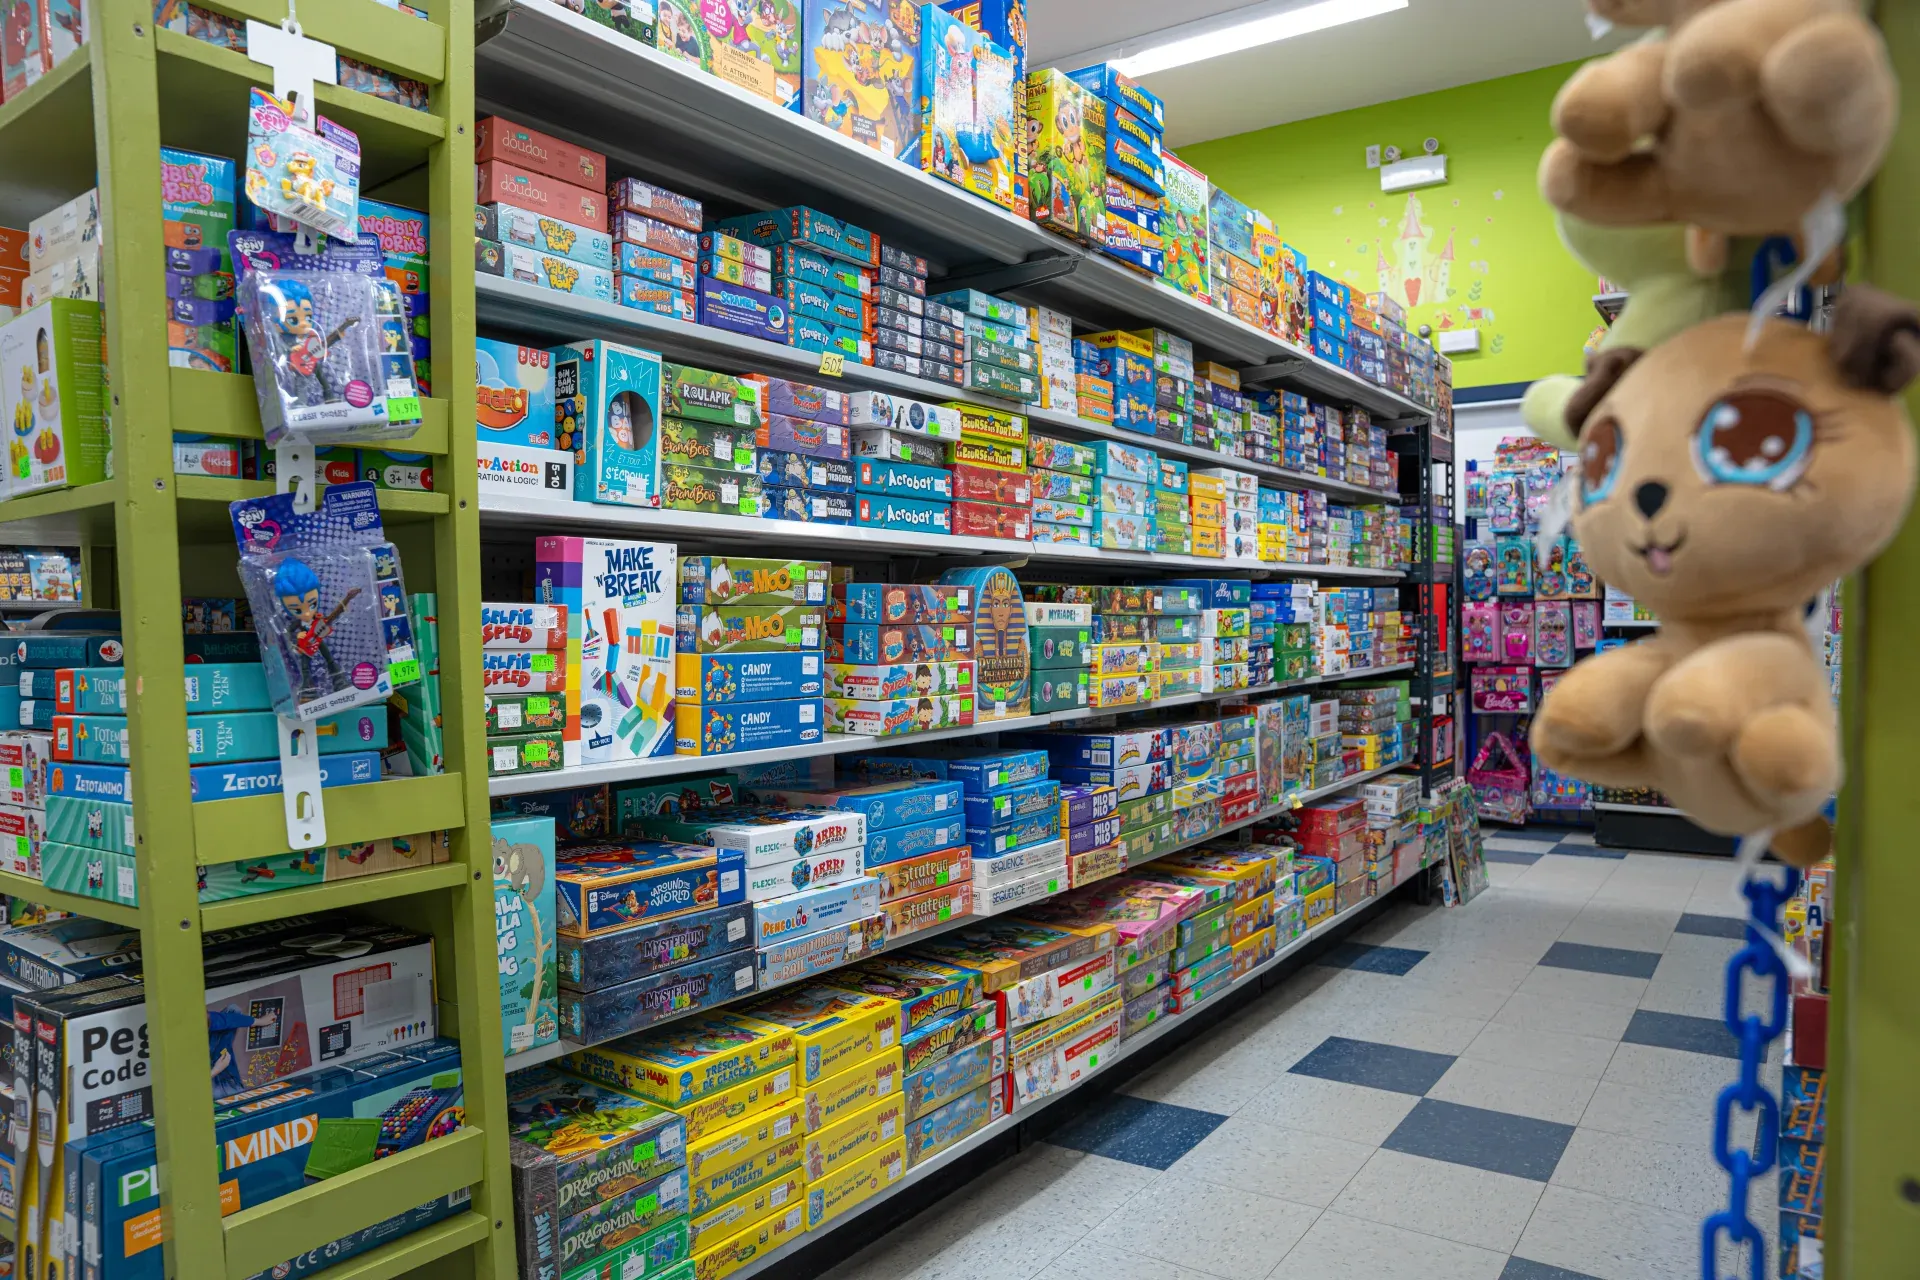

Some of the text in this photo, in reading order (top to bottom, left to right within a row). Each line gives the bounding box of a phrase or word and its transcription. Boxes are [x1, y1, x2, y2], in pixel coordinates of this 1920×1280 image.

[714, 4, 726, 15] 10
[730, 49, 755, 65] WARNING:
[730, 68, 758, 85] ATTENTION
[1119, 83, 1152, 113] PERFECTION
[1018, 81, 1028, 175] MONSTER
[1119, 117, 1150, 147] PERFECTION
[502, 130, 548, 161] doudou
[1119, 150, 1154, 178] PERFECTION
[500, 174, 547, 202] doudou
[744, 246, 756, 262] OXO
[655, 271, 671, 281] KIDS
[744, 267, 756, 284] OXO
[656, 304, 671, 313] KIDS
[1100, 335, 1117, 343] HABA
[823, 356, 843, 373] 50%
[793, 399, 822, 410] DRAGONS
[962, 418, 987, 431] BOURSE
[793, 433, 822, 445] DRAGONS
[963, 446, 987, 460] BOURSE
[332, 468, 349, 477] Kids
[390, 474, 402, 484] 3+
[514, 476, 538, 485] LOGIC!
[552, 464, 560, 487] 5-10
[341, 489, 372, 500] WARNING:
[605, 547, 654, 574] MAKE
[604, 570, 662, 598] BREAK
[735, 570, 753, 582] TIC
[734, 581, 754, 595] TAC
[725, 616, 745, 629] TIC
[483, 624, 533, 644] SPEED
[725, 628, 746, 643] TAC
[741, 663, 772, 676] CANDY
[979, 657, 1024, 675] PYRAMIDE
[221, 675, 229, 696] ZEN
[484, 670, 532, 688] SPEED
[101, 692, 115, 705] ZEN
[676, 687, 696, 696] beleduc
[741, 711, 771, 726] CANDY
[653, 725, 674, 753] Ravensburger
[676, 740, 696, 748] beleduc
[101, 742, 116, 755] ZEN
[949, 763, 980, 772] Ravensburger
[75, 774, 123, 796] ZETOTANIMO
[1092, 793, 1107, 808] PILO
[1093, 805, 1108, 818] PILO
[1095, 819, 1110, 835] PILO
[816, 826, 847, 849] ARRR!
[1095, 832, 1110, 846] PILO
[719, 853, 744, 863] Ravensburger
[990, 854, 1024, 874] SEQUENCE
[813, 859, 844, 882] ARRR!
[899, 858, 949, 889] Stratego
[650, 879, 684, 898] AROUND
[910, 877, 935, 890] JUNIOR
[599, 892, 619, 901] Disney
[650, 888, 690, 907] WORLD
[992, 883, 1026, 905] SEQUENCE
[901, 894, 951, 924] Stratego
[762, 914, 808, 938] PENGOLOO
[912, 913, 936, 926] JUNIOR
[644, 929, 703, 958] MYSTERIUM
[784, 931, 847, 963] AVENTURIERS
[821, 946, 841, 956] Premier
[662, 944, 689, 962] KIDS
[814, 956, 834, 967] Voyage
[782, 960, 807, 980] RAIL
[646, 978, 705, 1009] MYSTERIUM
[663, 993, 690, 1012] KIDS
[932, 991, 960, 1010] SLAM
[875, 1017, 897, 1033] HABA
[771, 1037, 793, 1053] HABA
[930, 1026, 956, 1049] SLAM
[822, 1034, 870, 1066] Rhino Hero Junior
[83, 1059, 147, 1090] Code
[706, 1055, 739, 1077] TRÉSOR
[875, 1060, 897, 1079] HABA
[646, 1069, 669, 1086] HABA
[703, 1067, 744, 1091] DE GLACE
[697, 1095, 729, 1117] Pyramide
[825, 1084, 868, 1116] Au chantier
[877, 1105, 899, 1125] HABA
[229, 1117, 314, 1170] MIND
[779, 1141, 799, 1158] HABA
[827, 1131, 870, 1163] Au chantier
[880, 1149, 901, 1169] HABA
[711, 1160, 754, 1190] DRAGON'S
[731, 1168, 763, 1190] BREATH
[826, 1173, 872, 1209] Rhino Hero Junior
[708, 1240, 740, 1264] Pyramide
